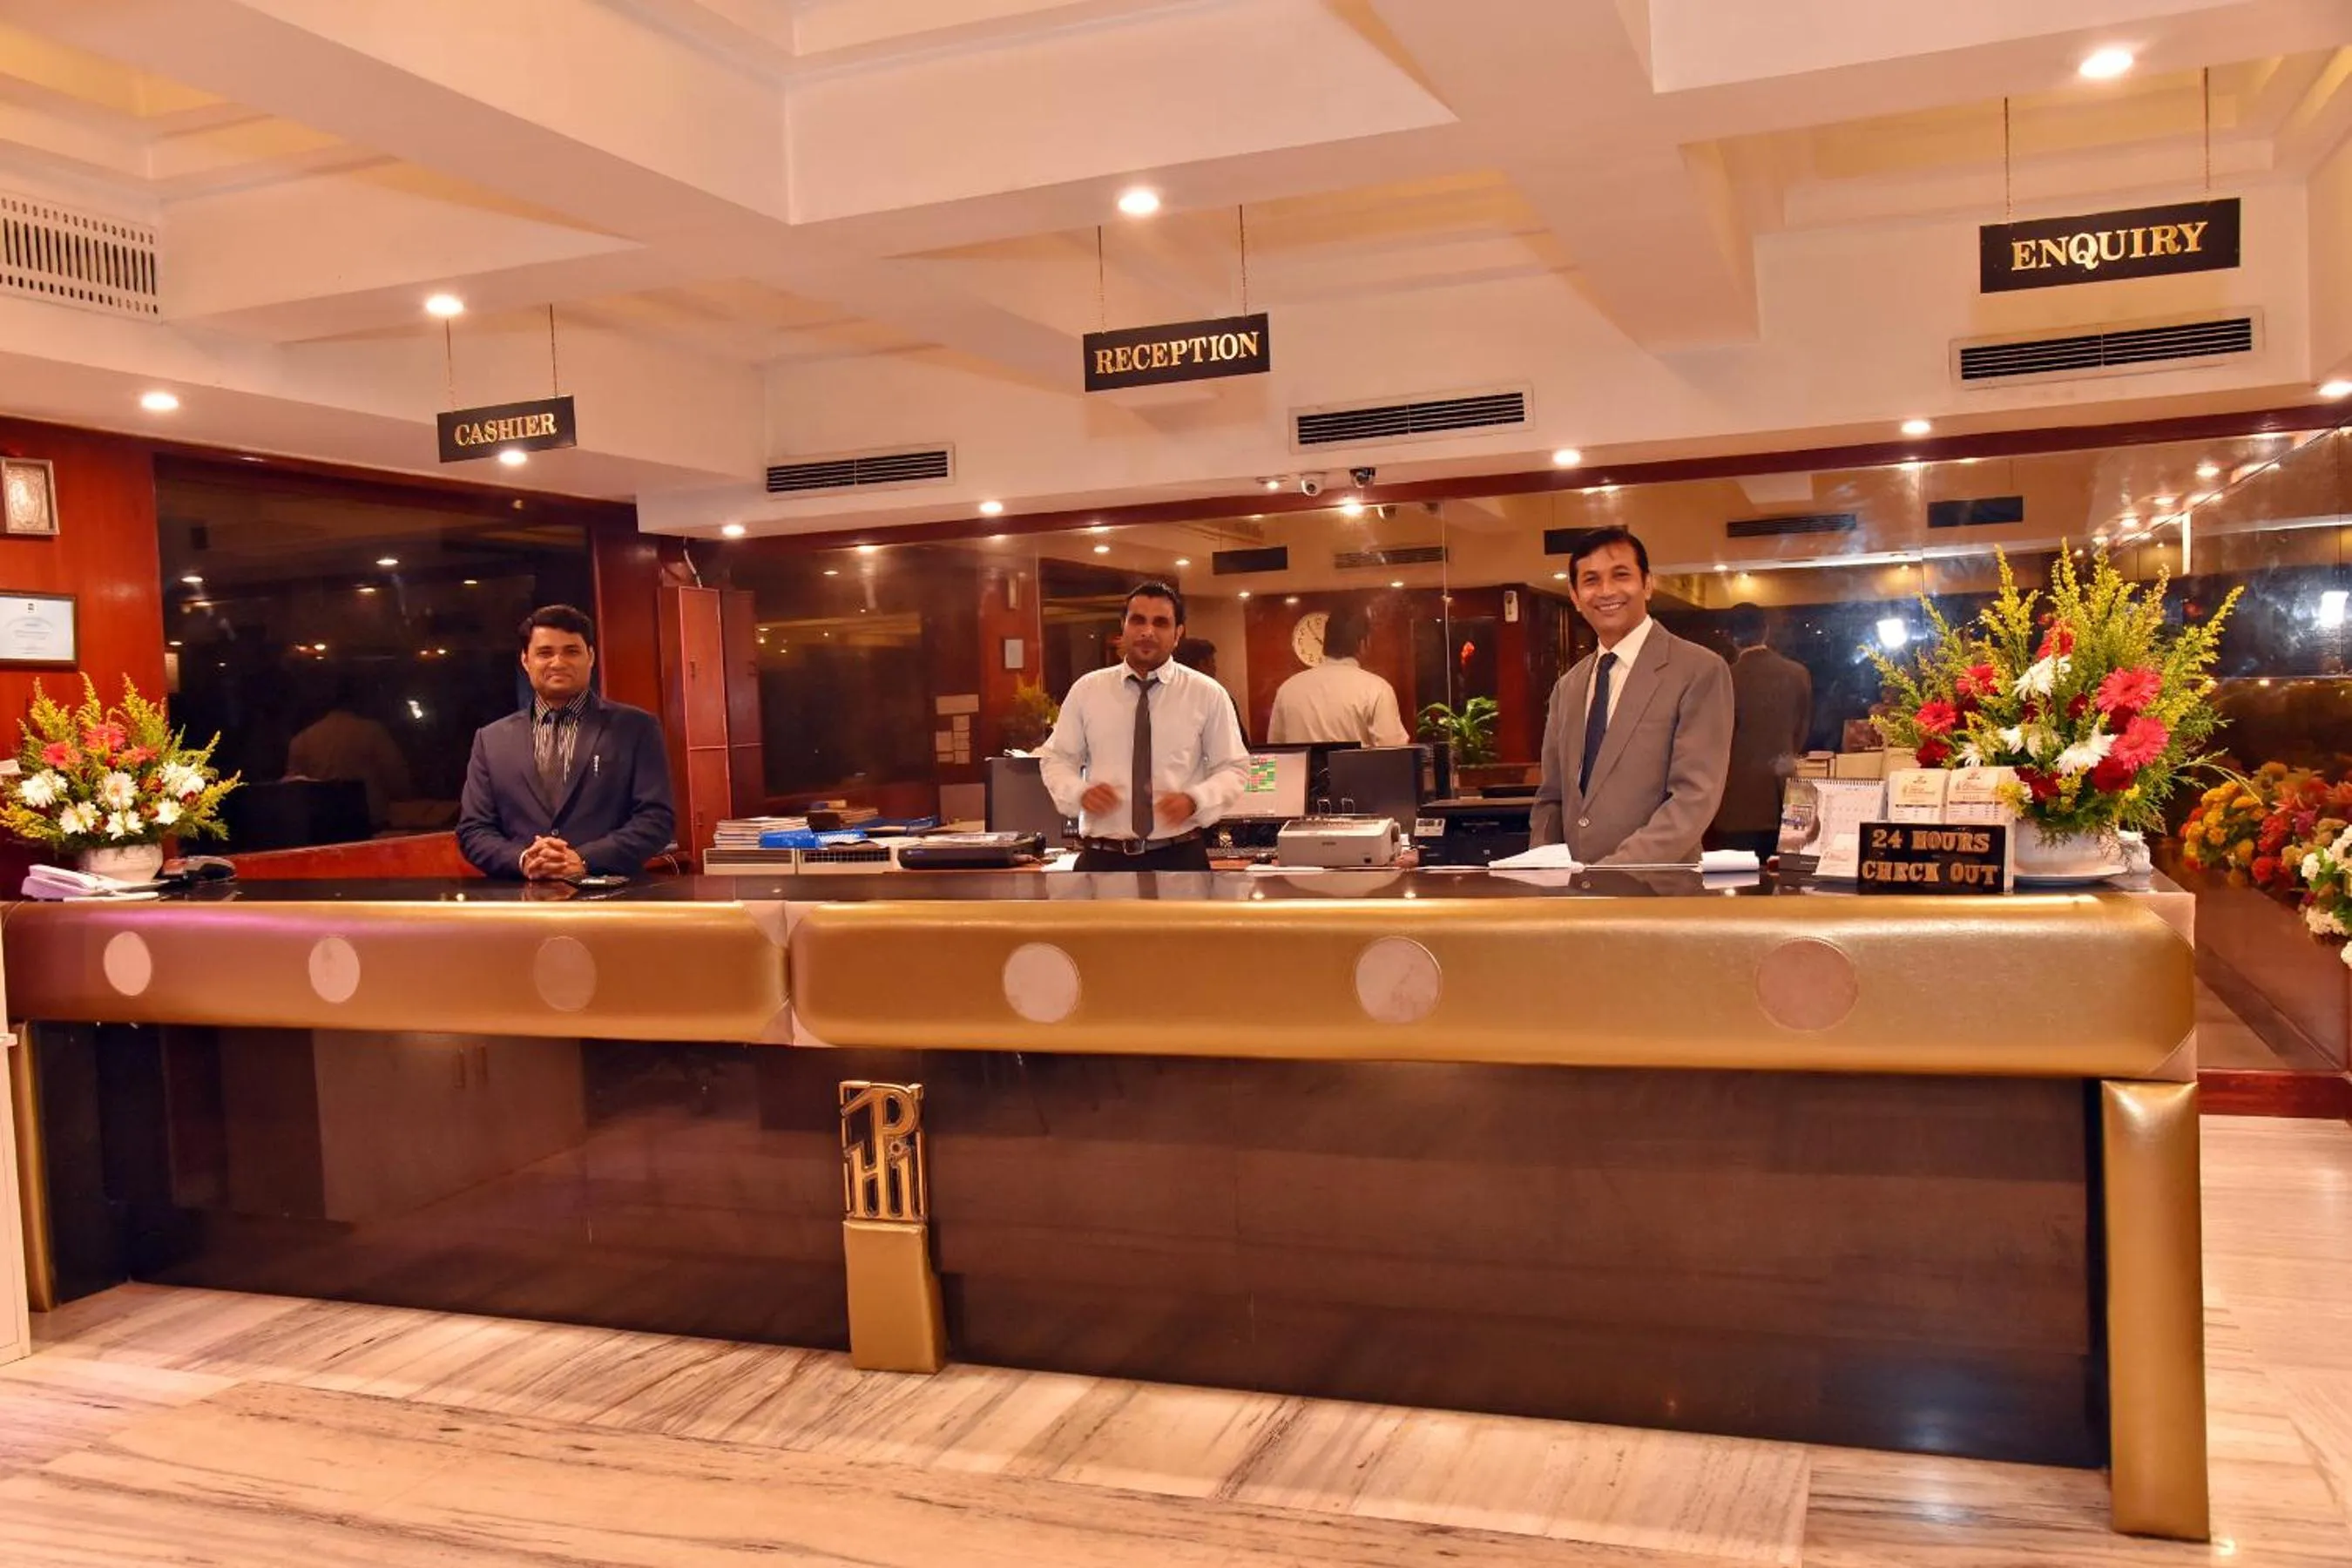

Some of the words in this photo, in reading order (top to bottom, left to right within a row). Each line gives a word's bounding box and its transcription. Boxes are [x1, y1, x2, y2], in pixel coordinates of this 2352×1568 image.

[2011, 220, 2208, 271] ENQUIRY
[1094, 331, 1260, 375] RECEPTION
[454, 413, 558, 446] CASHIER
[1871, 828, 1903, 849] 24
[1911, 830, 1990, 854] HOURS
[1862, 860, 1941, 882] CHECK
[1950, 862, 2001, 886] OUT
